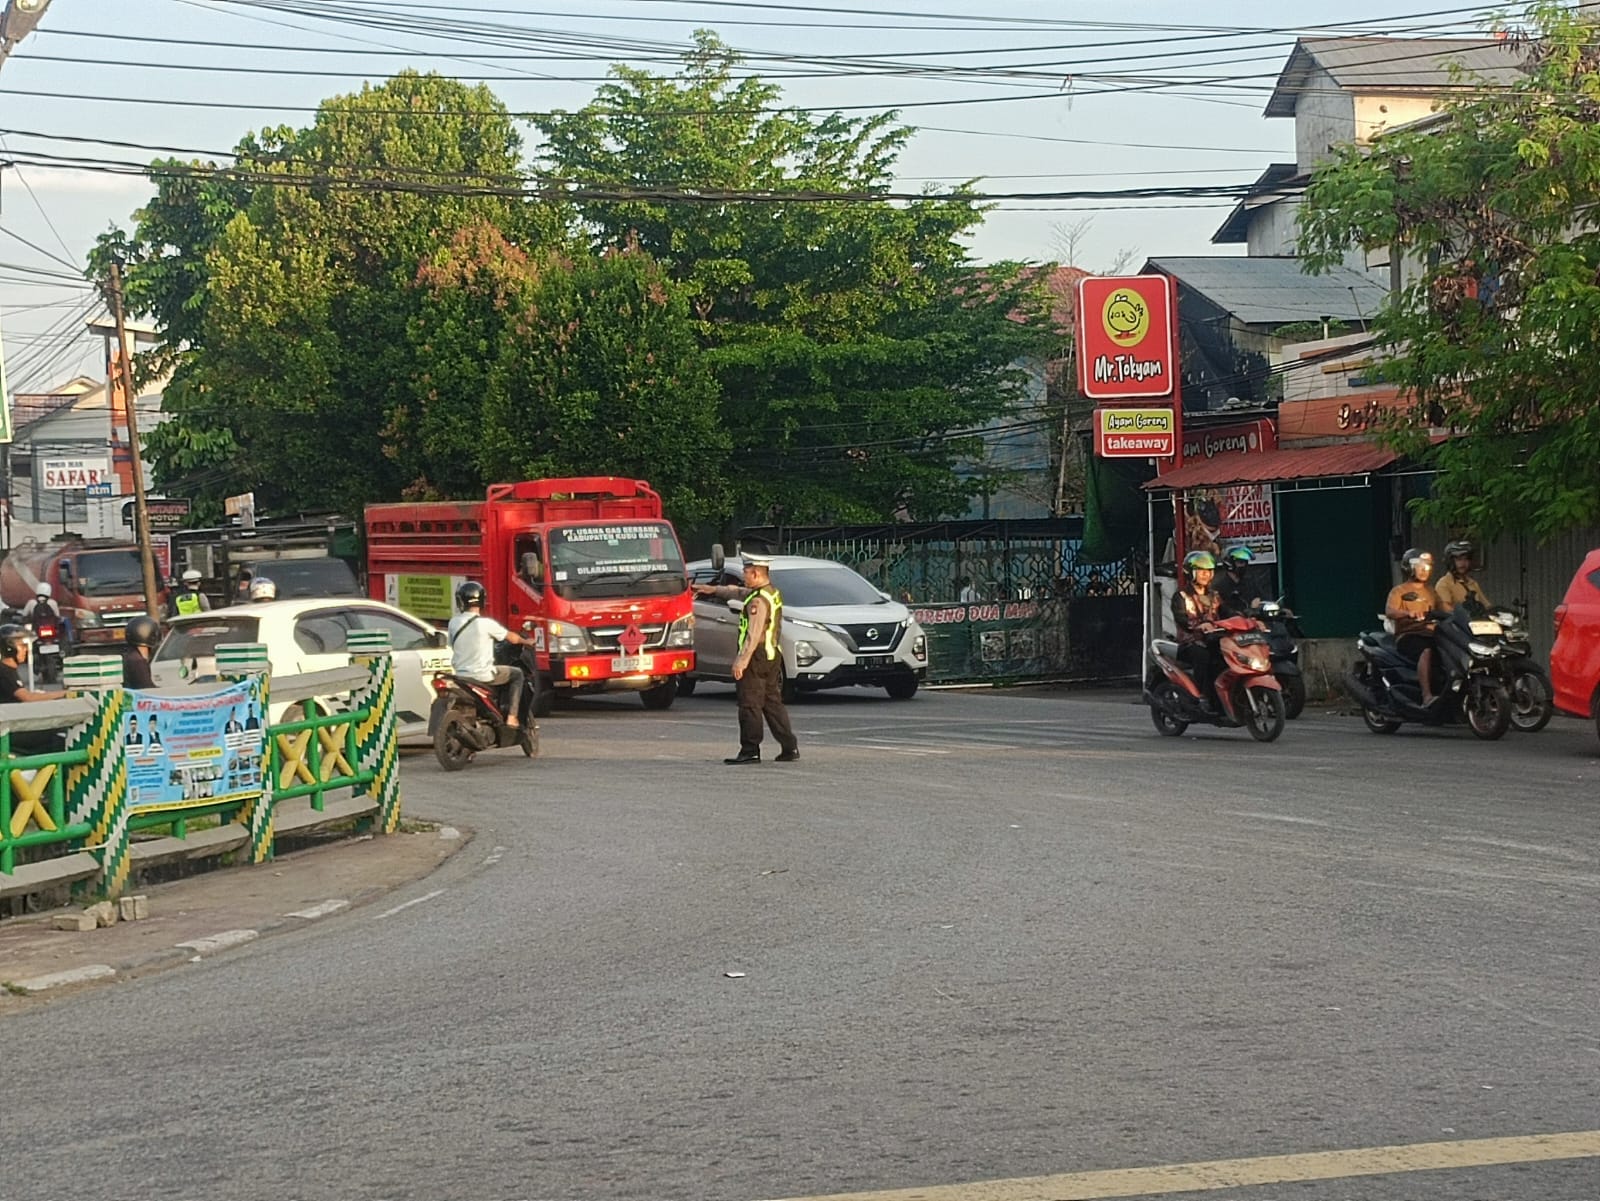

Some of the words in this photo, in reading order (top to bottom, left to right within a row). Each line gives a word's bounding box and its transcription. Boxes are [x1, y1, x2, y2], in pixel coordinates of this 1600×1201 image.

[1108, 414, 1134, 430] Ayam
[1136, 414, 1168, 430] Goreng
[1107, 437, 1169, 451] takeaway
[1205, 433, 1246, 458] Goreng
[89, 486, 110, 495] atm
[1226, 485, 1263, 503] AYAM
[577, 565, 618, 575] DILARANG
[911, 608, 965, 624] ORENG
[969, 605, 999, 621] DUA
